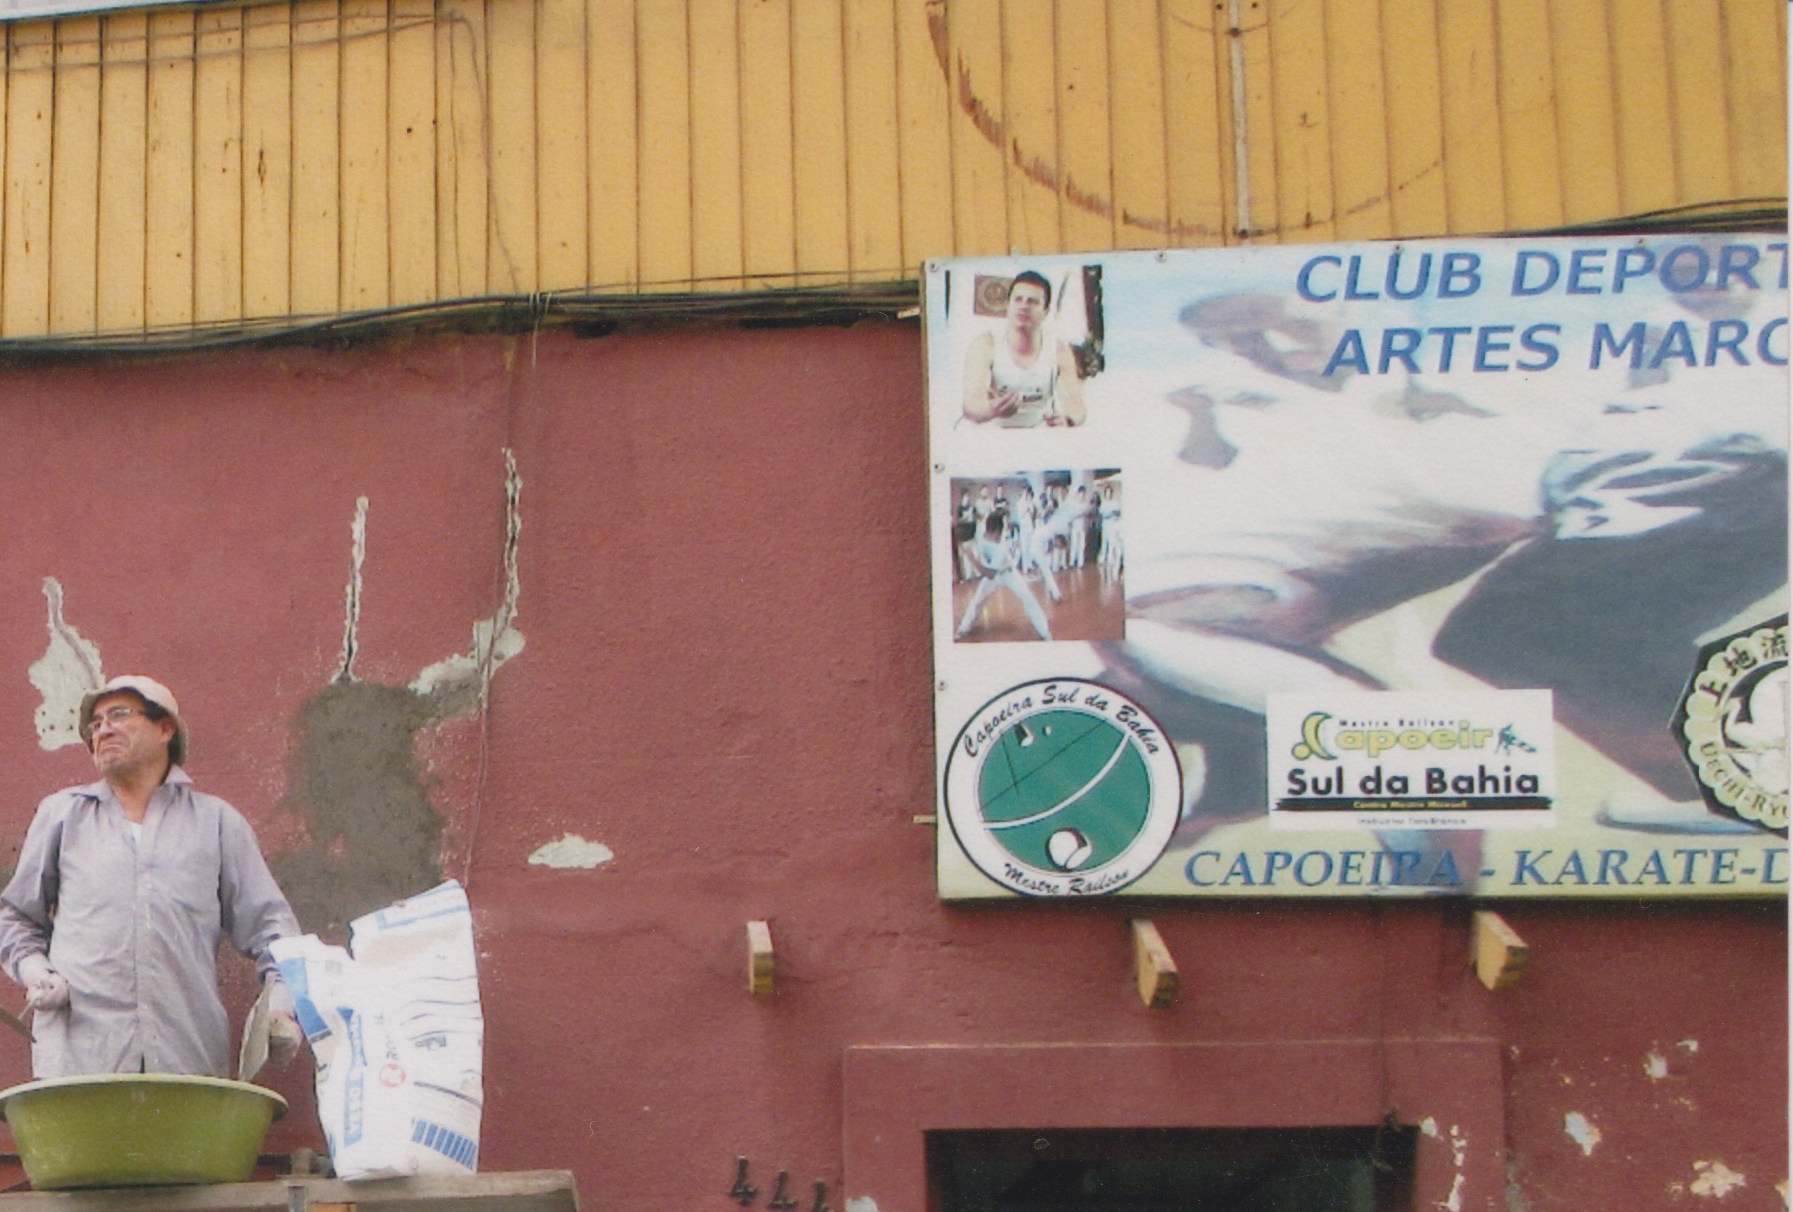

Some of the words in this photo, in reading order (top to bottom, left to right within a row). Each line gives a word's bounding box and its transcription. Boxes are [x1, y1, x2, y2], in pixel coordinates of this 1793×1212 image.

[1295, 248, 1482, 303] CLUB
[1322, 322, 1562, 378] ARTES
[963, 696, 1033, 759] Capoeira
[1041, 683, 1081, 706] Sul
[1084, 692, 1109, 712] da
[1115, 703, 1160, 755] Bahia
[1287, 766, 1344, 796] Sul
[1359, 765, 1410, 796] da
[1425, 764, 1540, 795] Bahia
[1004, 861, 1060, 896] Mestre
[1184, 848, 1466, 888] CAPOEIRA
